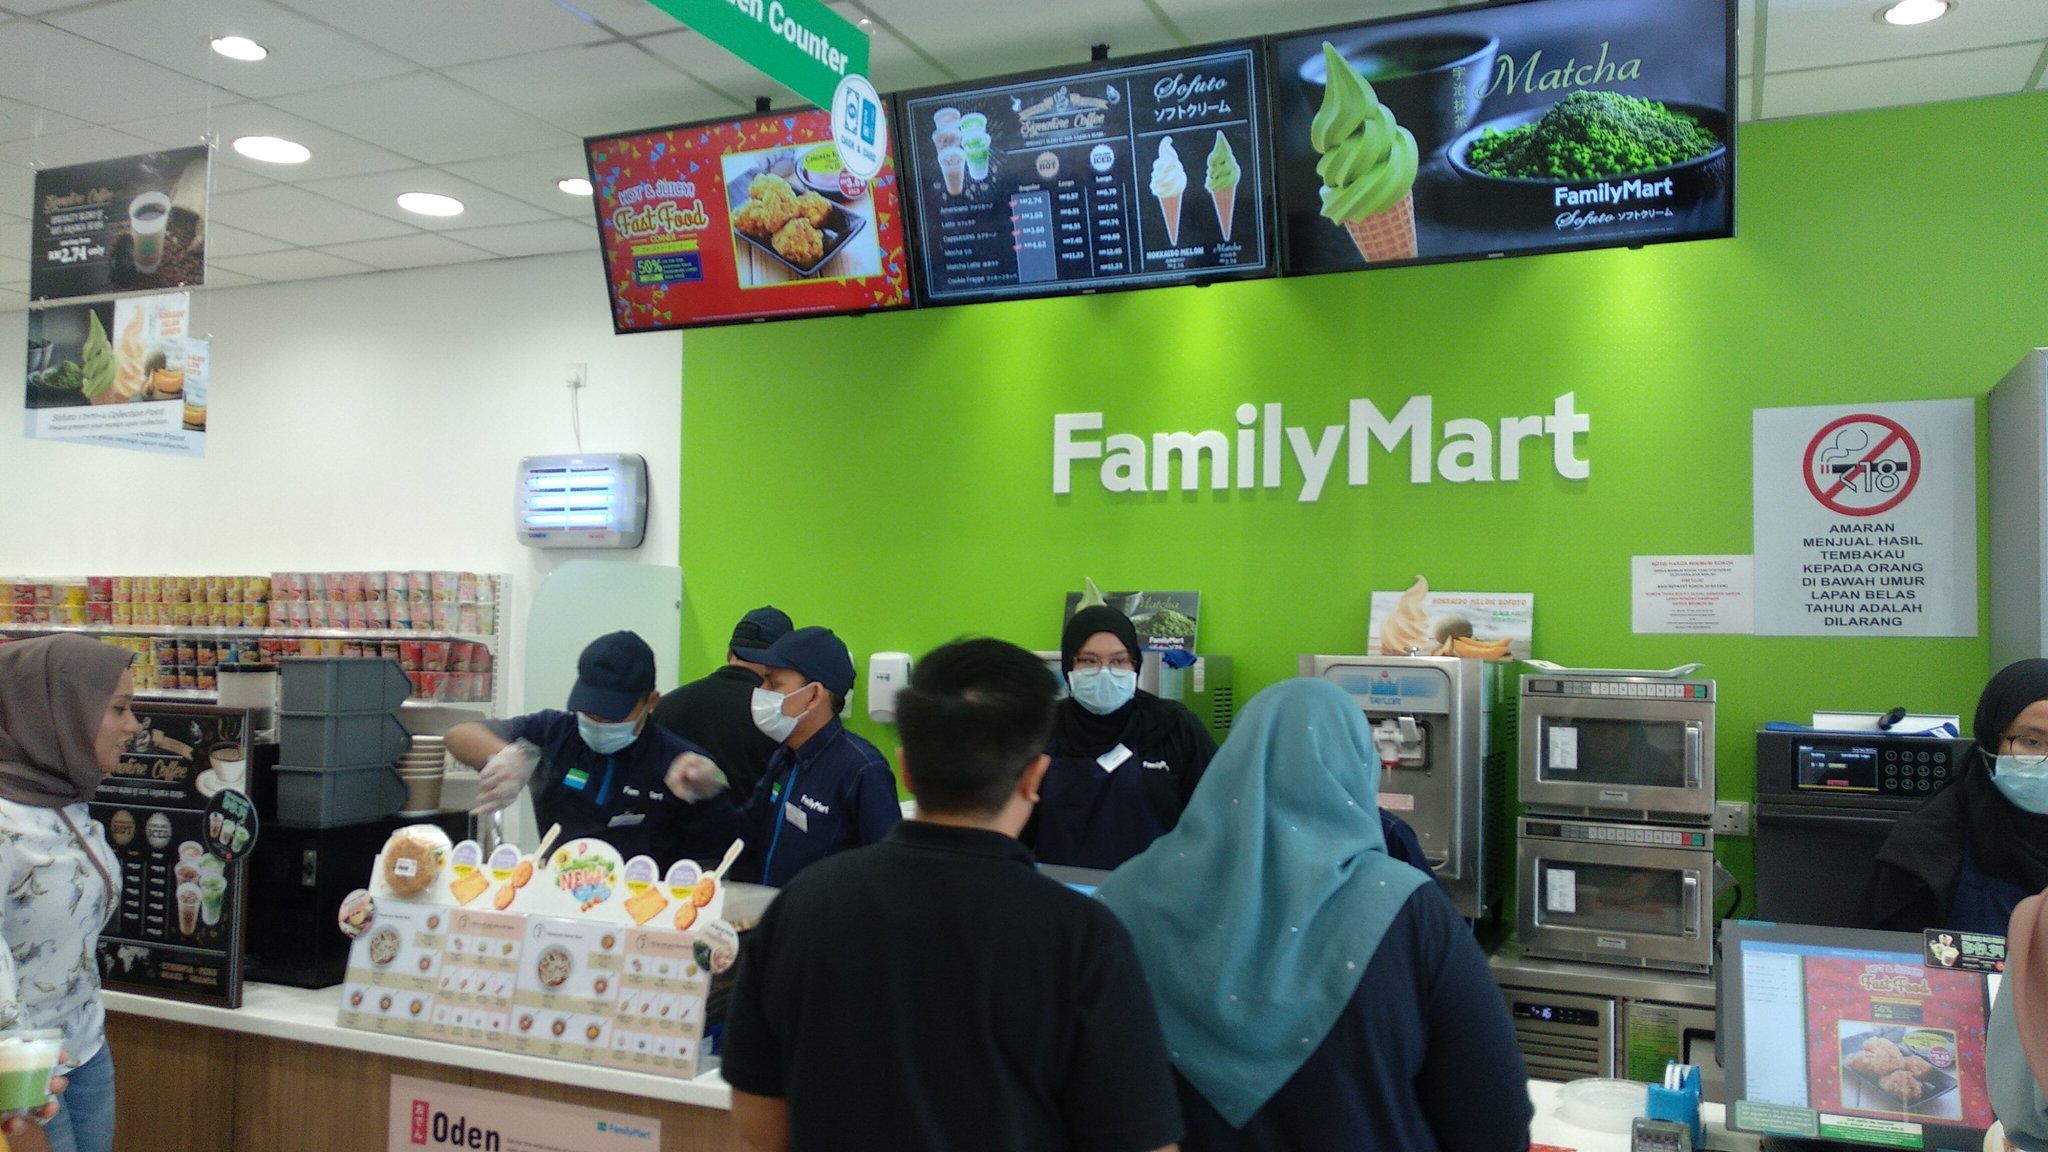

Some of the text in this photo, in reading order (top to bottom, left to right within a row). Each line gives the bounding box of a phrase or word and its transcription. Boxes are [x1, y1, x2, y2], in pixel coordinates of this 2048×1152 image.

[727, 0, 848, 75] en Counter
[1473, 41, 1641, 100] Matcha
[1154, 73, 1228, 102] Sofuto
[1155, 100, 1231, 122] ソフトクリーム
[619, 179, 695, 206] HOT & JUICY!
[1555, 177, 1673, 206] FamilyMart
[614, 201, 708, 236] Fast Food
[1555, 209, 1615, 231] Sofuto
[1180, 246, 1204, 257] MELON
[637, 259, 663, 275] 50%
[1053, 391, 1589, 501] FamilyMart
[1829, 523, 1895, 533] AMARAN
[1803, 536, 1923, 547] MENJUAL HASIL
[1820, 550, 1904, 560] TEMBAKAU
[1803, 563, 1923, 573] KEPADA ORANG
[1802, 576, 1925, 587] DI BAWAH UMUR
[1811, 590, 1915, 600] LAPAN BELAS
[1805, 603, 1922, 613] TAHUN ADALAH
[1824, 617, 1902, 626] DILARANG
[1149, 636, 1184, 644] FamilyMart
[152, 759, 187, 780] Coffee
[1860, 974, 1931, 995] Fast Food
[433, 1111, 500, 1152] Oden
[608, 1124, 652, 1140] FamilyMart
